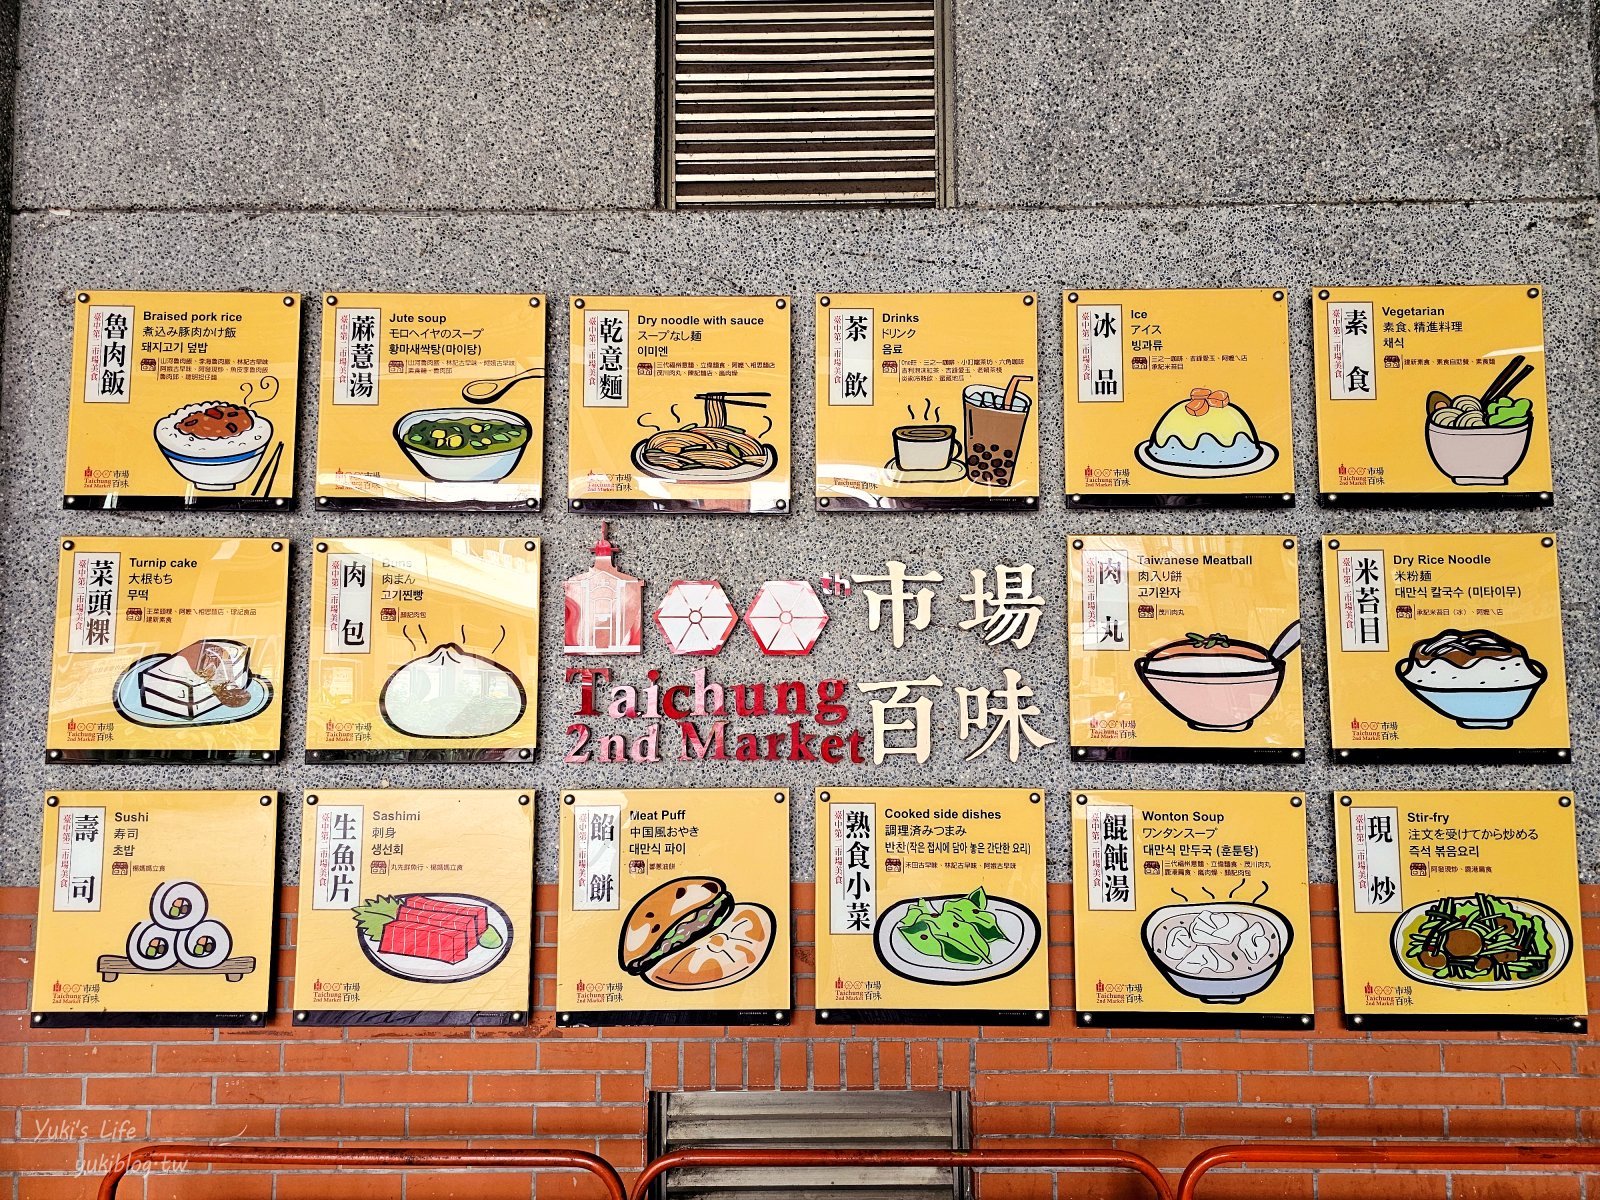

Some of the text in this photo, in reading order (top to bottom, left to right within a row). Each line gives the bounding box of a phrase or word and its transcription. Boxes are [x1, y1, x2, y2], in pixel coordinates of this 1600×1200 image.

[143, 311, 242, 323] Braised pork rice
[882, 313, 920, 323] Drinks
[1131, 309, 1148, 319] Ice
[1382, 306, 1445, 319] Vegetarian
[389, 313, 447, 325] Jute soup
[637, 315, 764, 327] Dry noodle with sauce
[143, 326, 236, 338] 煮込み豚肉かけ飯
[1130, 324, 1162, 335] アイス
[1383, 321, 1463, 333] 素食、精進料理
[389, 328, 484, 339] モロヘイヤのスープ
[882, 328, 916, 339] ドリンク
[90, 312, 101, 381] 臺中第二市場美食
[141, 342, 208, 354] 돼지고기 덮밥
[1081, 312, 1091, 381] 臺中第二市場美食
[1131, 340, 1163, 352] 빙과류
[1332, 309, 1343, 379] 臺中第二市場美食
[1383, 337, 1404, 349] 채식
[101, 313, 128, 396] 魯肉飯
[339, 315, 348, 384] 臺中第二市場美食
[389, 344, 482, 356] 황마새싹탕(마이탕)
[588, 316, 597, 386] 臺中第二市場美食
[637, 346, 668, 357] 이미엔
[833, 316, 842, 384] 臺中第二市場美食
[882, 344, 903, 355] 음료
[1093, 312, 1118, 396] 冰品
[1344, 309, 1371, 393] 素食
[350, 315, 375, 397] 蔴薏湯
[599, 317, 623, 401] 乾意麵
[844, 315, 868, 399] 茶飲
[1367, 467, 1385, 475] 市場
[1368, 476, 1385, 486] 百味
[129, 557, 198, 569] Turnip cake
[1137, 555, 1253, 565] Taiwanese Meatball
[1393, 555, 1491, 567] Dry Rice Noodle
[128, 573, 173, 584] 大根もち
[382, 573, 416, 585] 肉まん
[820, 570, 851, 597] th
[75, 559, 87, 631] 臺中第二市場美食
[127, 589, 149, 601] 무떡
[330, 560, 340, 632] 臺中第二市場美食
[381, 589, 424, 601] 고기찐빵
[1138, 587, 1181, 598] 고기완자
[1342, 557, 1354, 629] 臺中第二市場美食
[1395, 586, 1521, 598] 대만식 칼국수 (미타이무)
[85, 559, 114, 646] 菜頭粿
[341, 560, 366, 646] 肉包
[851, 560, 1046, 650] 市場
[1098, 558, 1124, 643] 肉丸
[1355, 557, 1380, 644] 米苔目
[565, 667, 850, 728] Taichung
[856, 668, 1057, 765] 百味
[96, 722, 114, 732] 市場
[96, 733, 114, 742] 百味
[564, 721, 866, 764] 2nd Market
[114, 812, 149, 822] Sushi
[372, 811, 421, 821] Sashimi
[630, 810, 686, 820] Meat Puff
[885, 808, 1002, 819] Cooked side dishes
[1142, 811, 1225, 823] Wonton Soup
[1407, 812, 1449, 824] Stir-fry
[114, 828, 139, 839] 寿司
[372, 827, 396, 838] 刺身
[630, 826, 699, 838] 中国風おやき
[885, 824, 967, 837] 調理済みつまみ
[1142, 827, 1218, 839] ワンタンスープ
[1408, 828, 1539, 841] 注文を受けてから炒める
[60, 815, 71, 888] 臺中第二市場美食
[113, 845, 135, 856] 초밥
[319, 812, 330, 887] 臺中第二市場美食
[371, 844, 403, 855] 생선회
[578, 813, 587, 887] 臺中第二市場美食
[629, 843, 686, 855] 대만식 파이
[834, 810, 843, 885] 臺中第二市場美食
[885, 841, 1031, 855] 반찬(작은 접시에 담아 놓은 간단한 요리)
[1143, 844, 1259, 858] 대만식 만두국 (훈툰탕)
[1355, 815, 1367, 889] 臺中第二市場美食
[1408, 845, 1479, 857] 즉석 볶음요리
[72, 815, 99, 903] 壽司
[330, 813, 357, 903] 生魚片
[590, 813, 614, 902] 餡餅
[1103, 813, 1130, 903] 餛飩湯
[1367, 815, 1396, 905] 現炒
[846, 810, 871, 931] 熟食小菜
[83, 984, 100, 993] 市場
[1125, 984, 1143, 993] 市場
[82, 994, 100, 1004] 百味
[1126, 994, 1144, 1004] 百味
